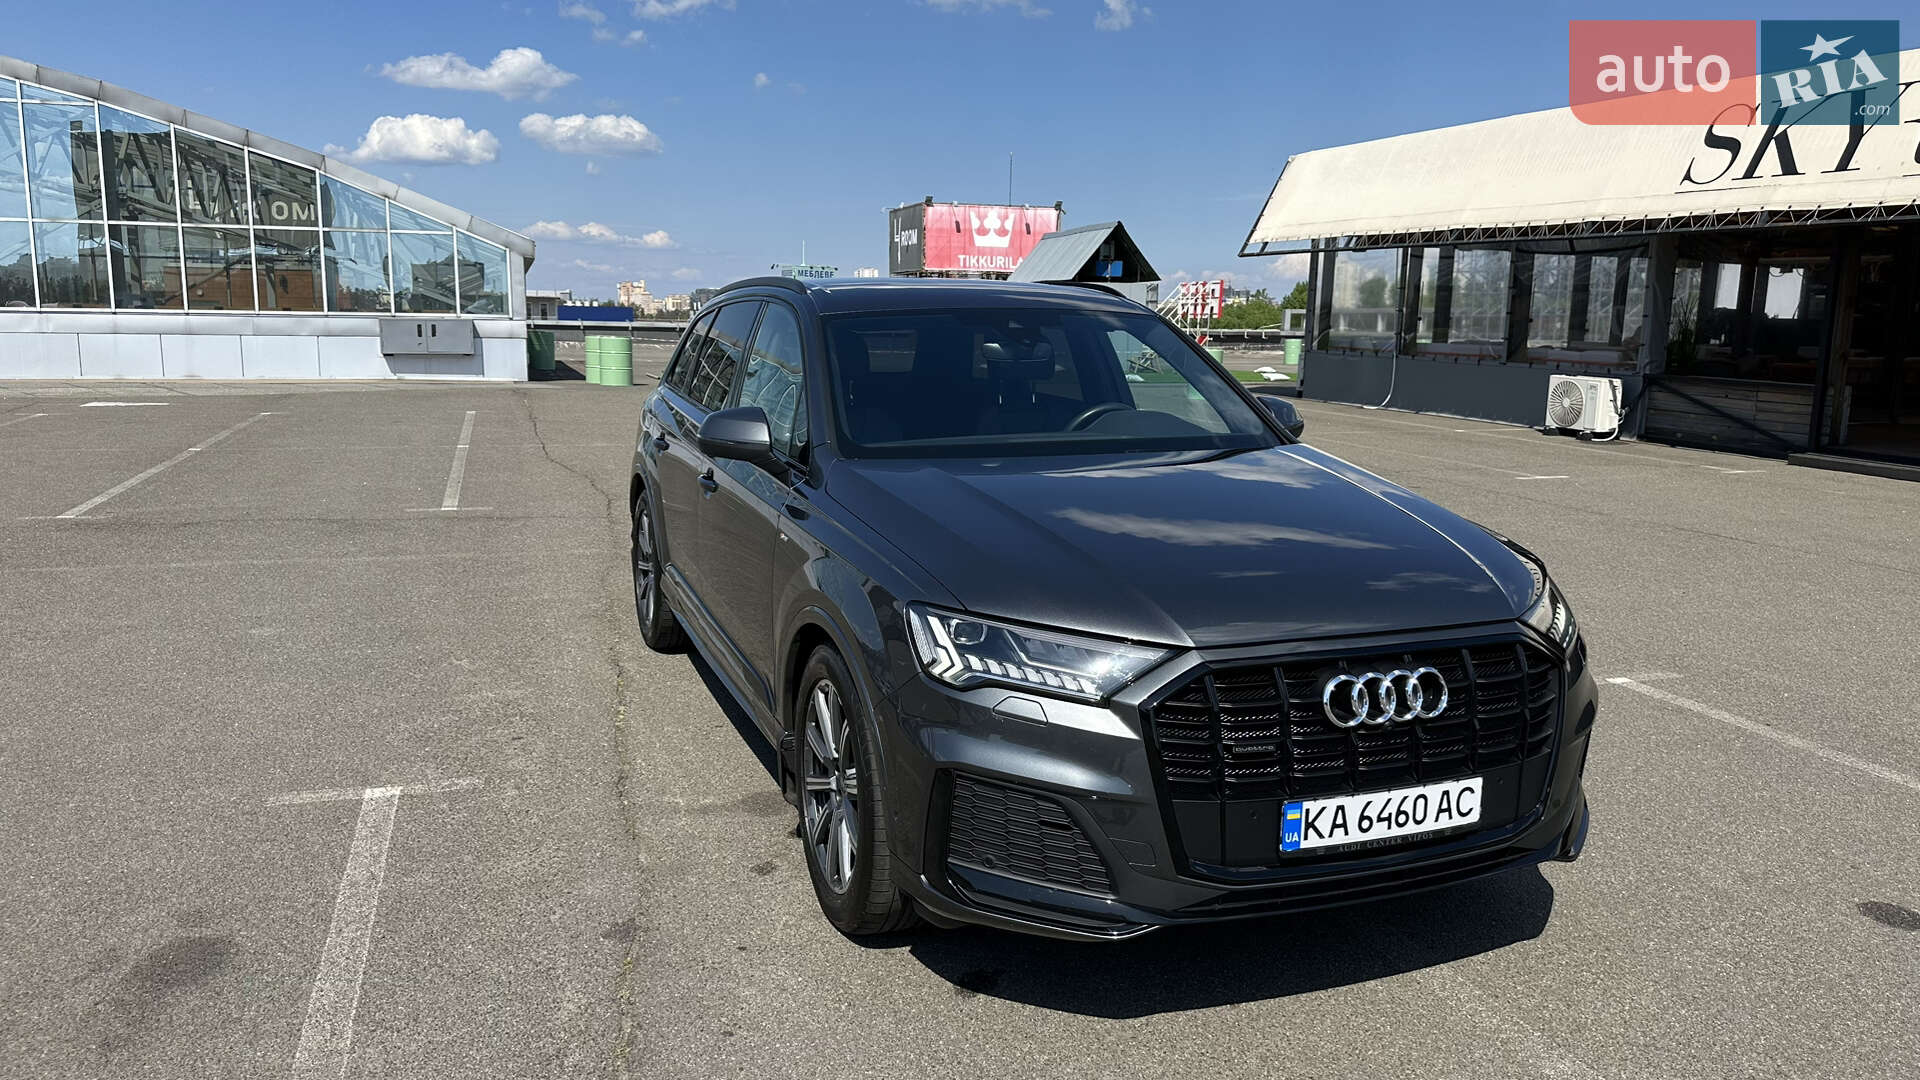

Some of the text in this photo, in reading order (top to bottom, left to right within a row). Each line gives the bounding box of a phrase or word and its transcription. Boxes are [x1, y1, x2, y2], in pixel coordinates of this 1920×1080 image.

[1679, 81, 1920, 185] SKY
[901, 228, 919, 247] ROOM
[1303, 786, 1476, 842] KA 6460 AC
[1285, 832, 1300, 844] UA
[1366, 837, 1403, 849] CENTER
